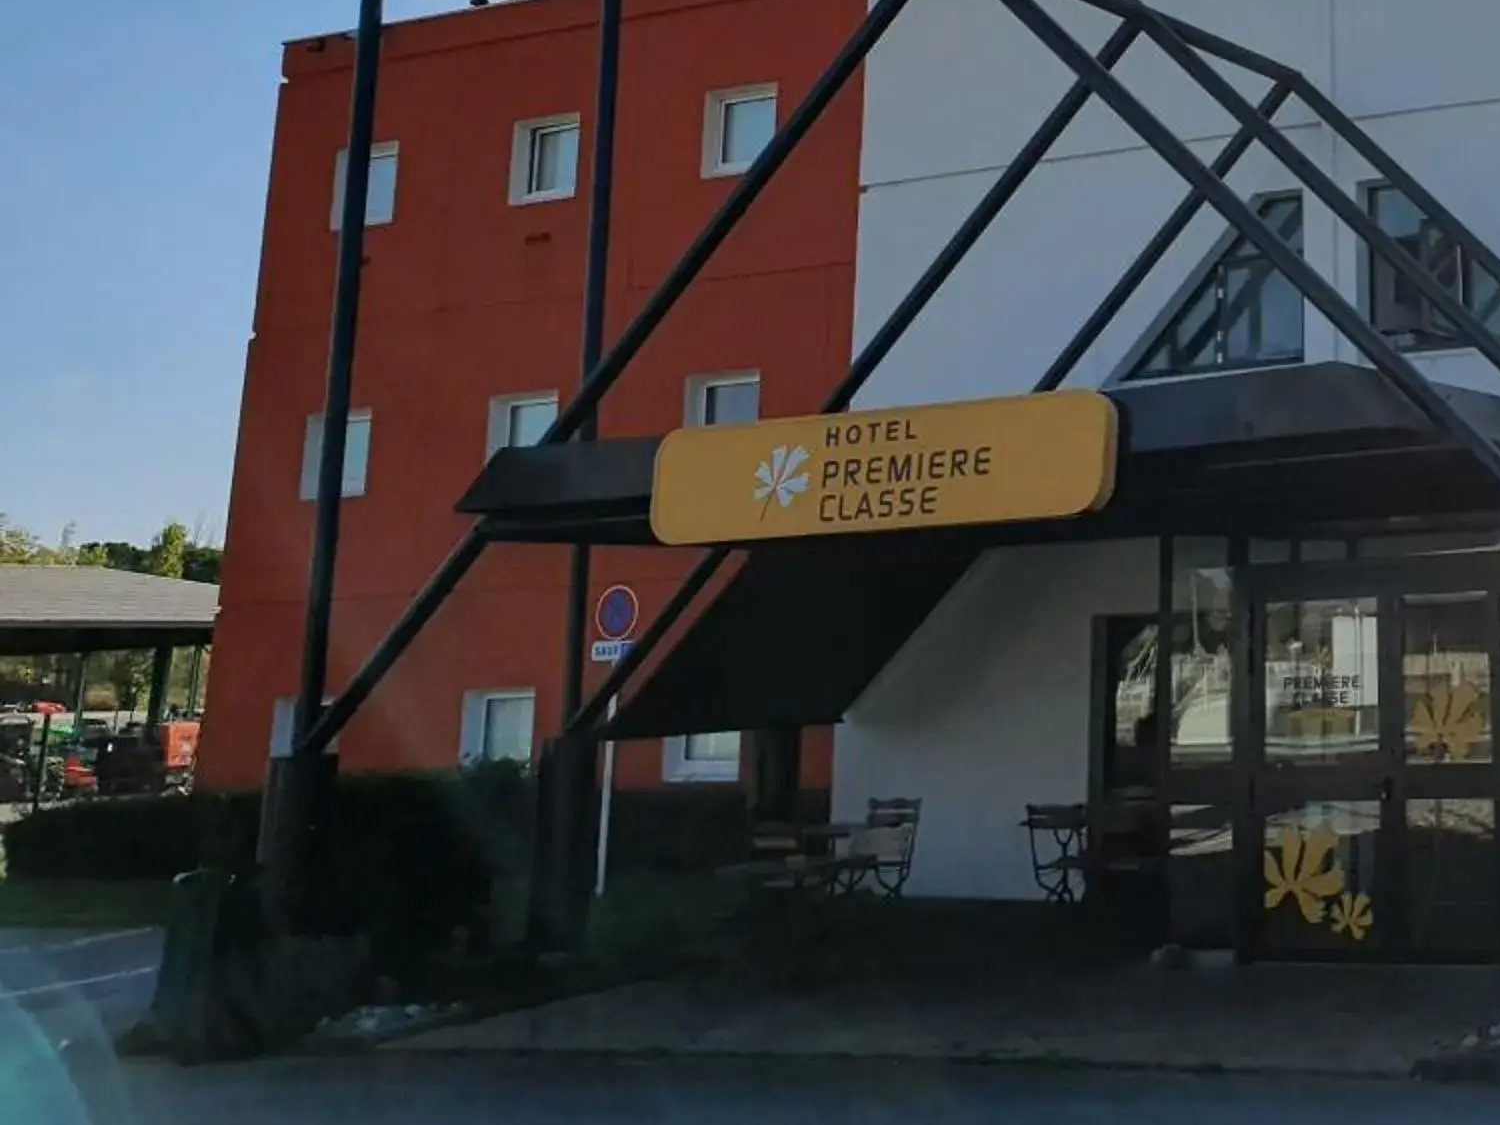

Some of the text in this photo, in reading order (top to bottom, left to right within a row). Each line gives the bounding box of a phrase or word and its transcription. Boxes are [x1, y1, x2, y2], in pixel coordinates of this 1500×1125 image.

[826, 419, 918, 448] HOTEL
[822, 446, 993, 489] PREMIERE
[819, 486, 940, 522] CLASSE
